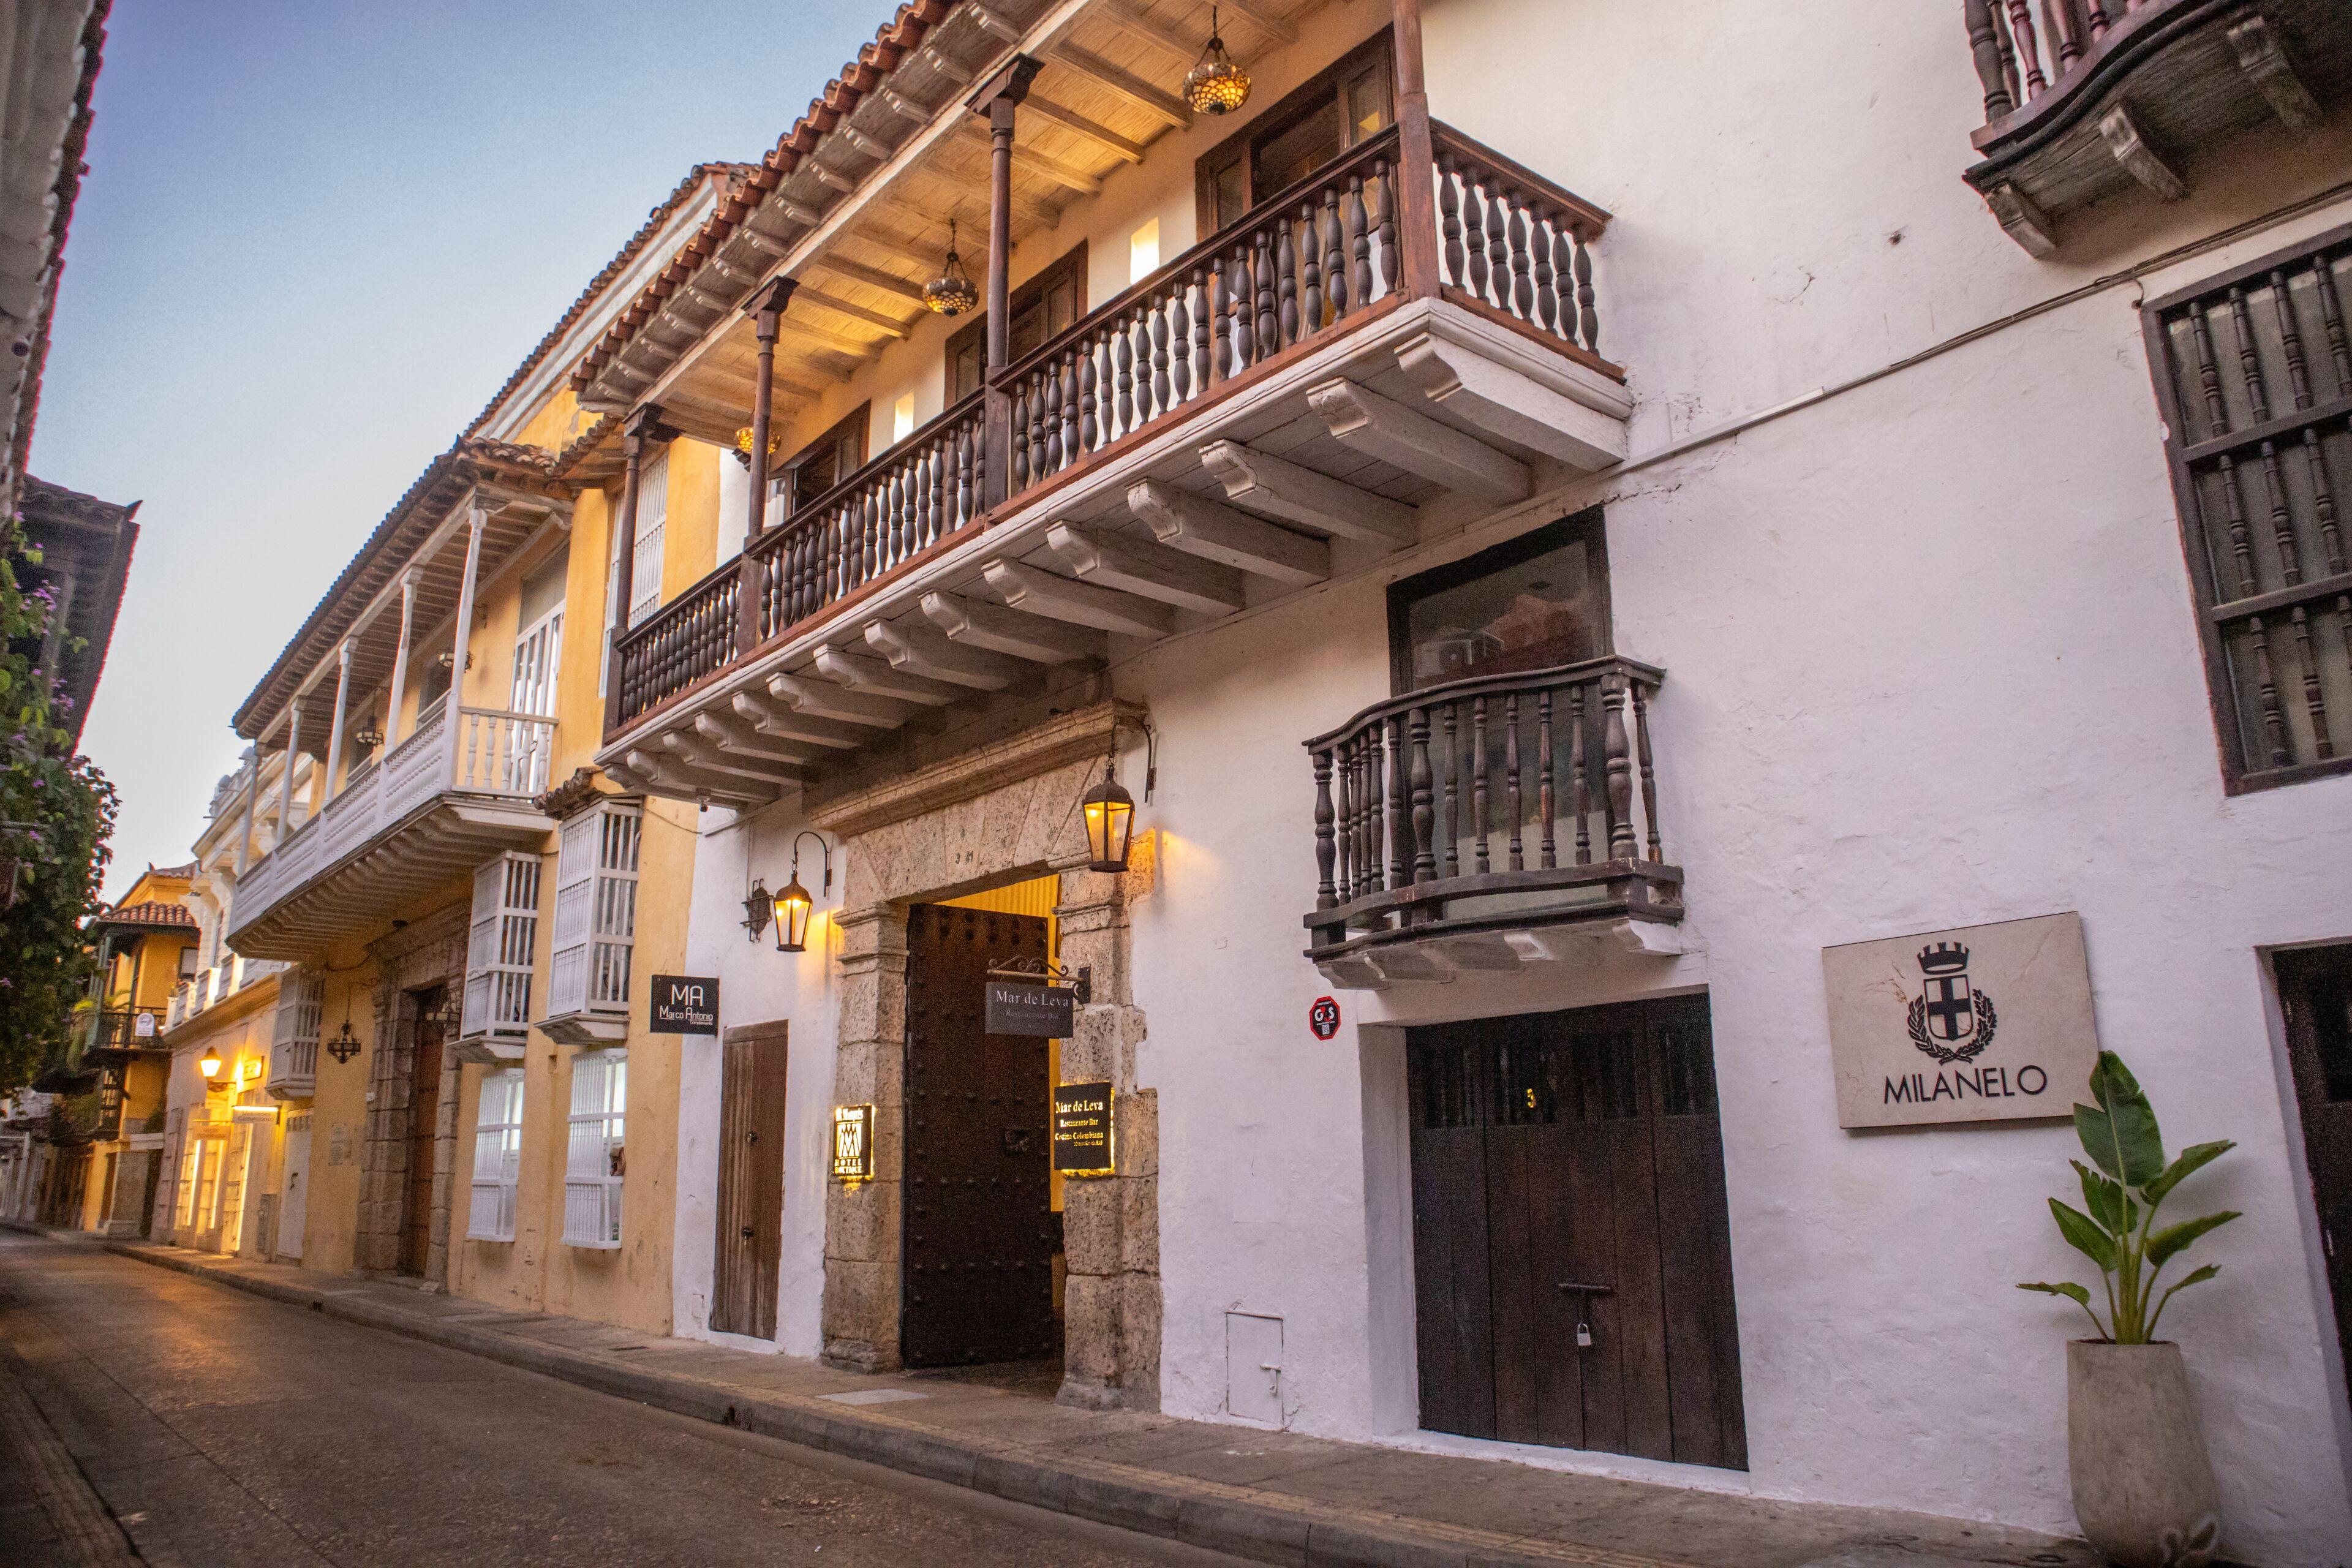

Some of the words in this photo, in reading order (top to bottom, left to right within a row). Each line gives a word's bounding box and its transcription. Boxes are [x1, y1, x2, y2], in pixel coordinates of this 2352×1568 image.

[671, 984, 703, 1006] MA
[997, 990, 1020, 1003] Mar
[1024, 992, 1038, 1005] de
[1042, 993, 1069, 1007] Leva
[660, 1005, 684, 1019] Marco
[685, 1007, 713, 1021] Antonio
[1884, 1065, 2048, 1104] MILANELO
[1055, 1101, 1071, 1114] Mar
[1072, 1101, 1082, 1112] de
[1084, 1100, 1103, 1111] Leva
[1060, 1119, 1088, 1128] Restaurante
[1072, 1131, 1103, 1140] Colombiana
